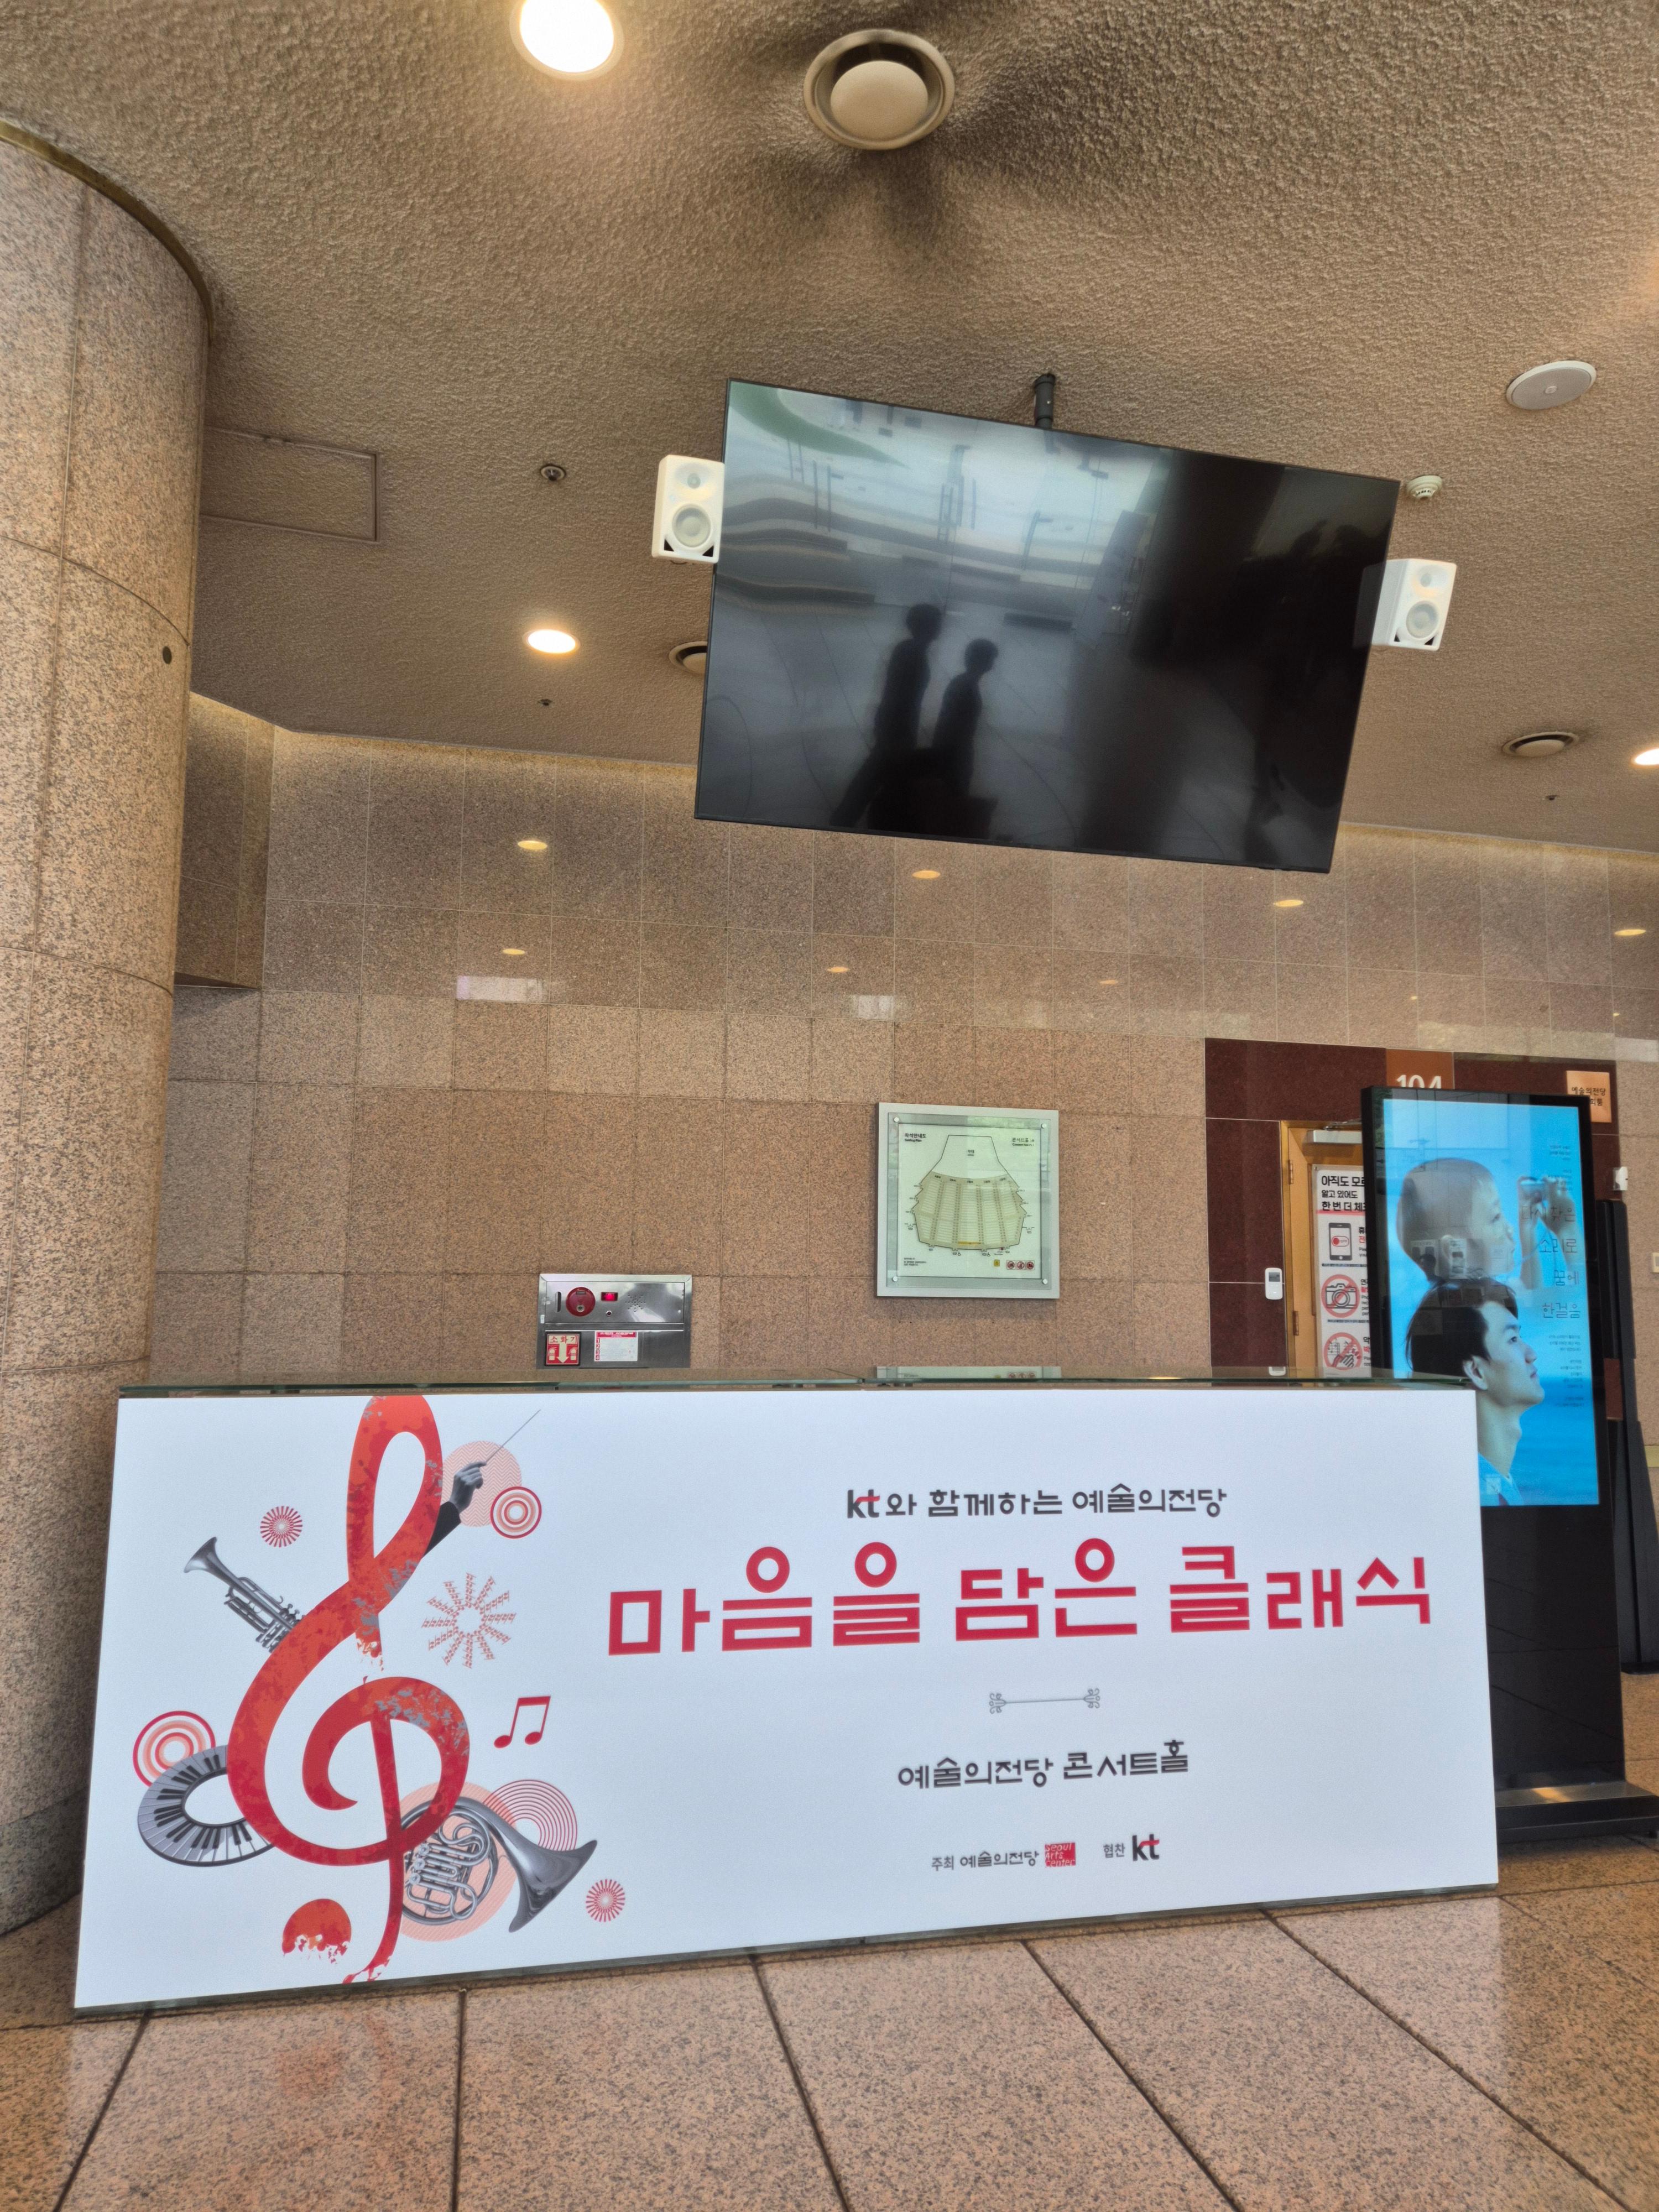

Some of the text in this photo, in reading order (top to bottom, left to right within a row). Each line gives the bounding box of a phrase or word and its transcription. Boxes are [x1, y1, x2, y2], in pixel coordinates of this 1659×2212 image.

[1571, 1087, 1606, 1096] 예술의전당
[1321, 1176, 1350, 1187] 아직도
[1321, 1190, 1359, 1199] 알고 있어도
[1321, 1201, 1331, 1211] 한
[1332, 1201, 1342, 1212] 번
[1343, 1202, 1352, 1212] 더
[1551, 1206, 1576, 1222] 찾은
[1539, 1238, 1578, 1254] 소리로
[1554, 1270, 1579, 1286] 꿈에
[1542, 1302, 1580, 1318] 한걸음
[550, 1334, 578, 1344] 소화기
[847, 1483, 1227, 1519] kt와 함께하는 예술의전당
[608, 1537, 1431, 1656] 마음을 담은 클래식
[898, 1739, 1188, 1789] 예술의전당 콘서트홀
[1103, 1833, 1160, 1861] 협찬 kt
[931, 1850, 1040, 1871] 주최 예술의전당
